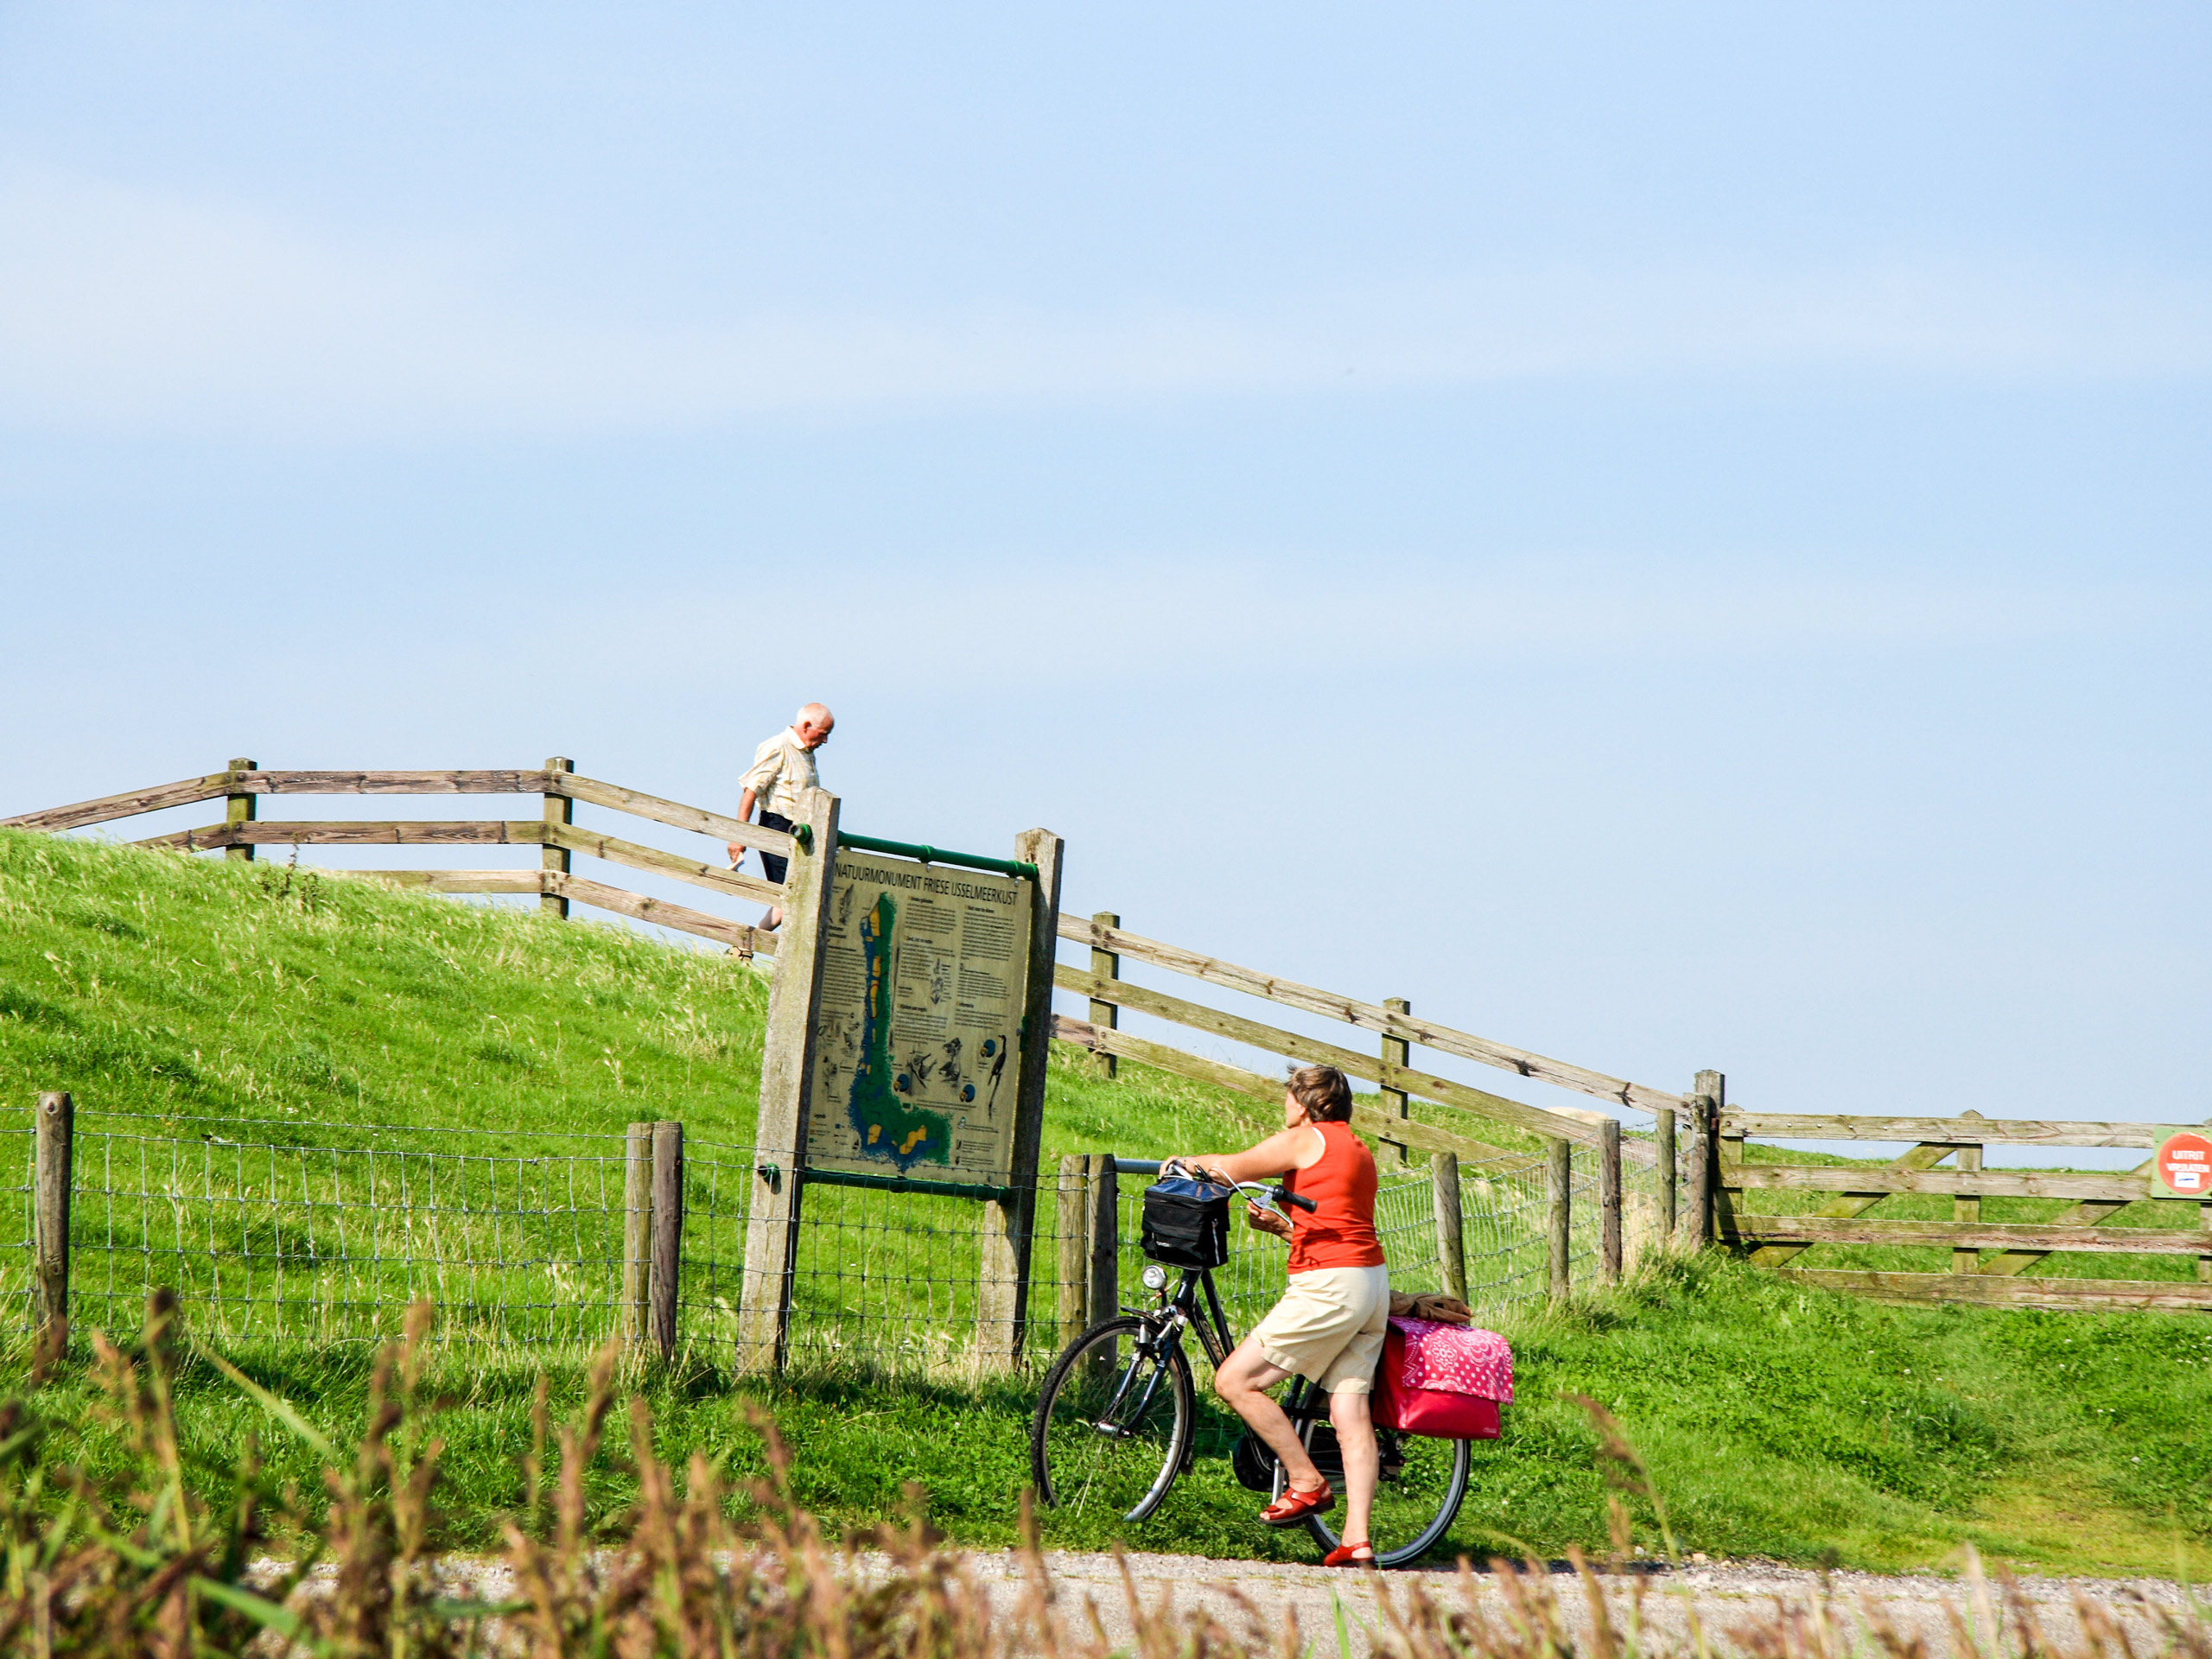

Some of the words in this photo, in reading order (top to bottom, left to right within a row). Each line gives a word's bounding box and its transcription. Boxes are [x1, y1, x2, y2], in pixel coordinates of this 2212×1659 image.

[835, 863, 922, 890] NATUURMONUMENT
[924, 877, 950, 895] FRIESE
[952, 883, 1018, 906] IJSSELMEERKUST
[2171, 1150, 2205, 1160] UITRIT
